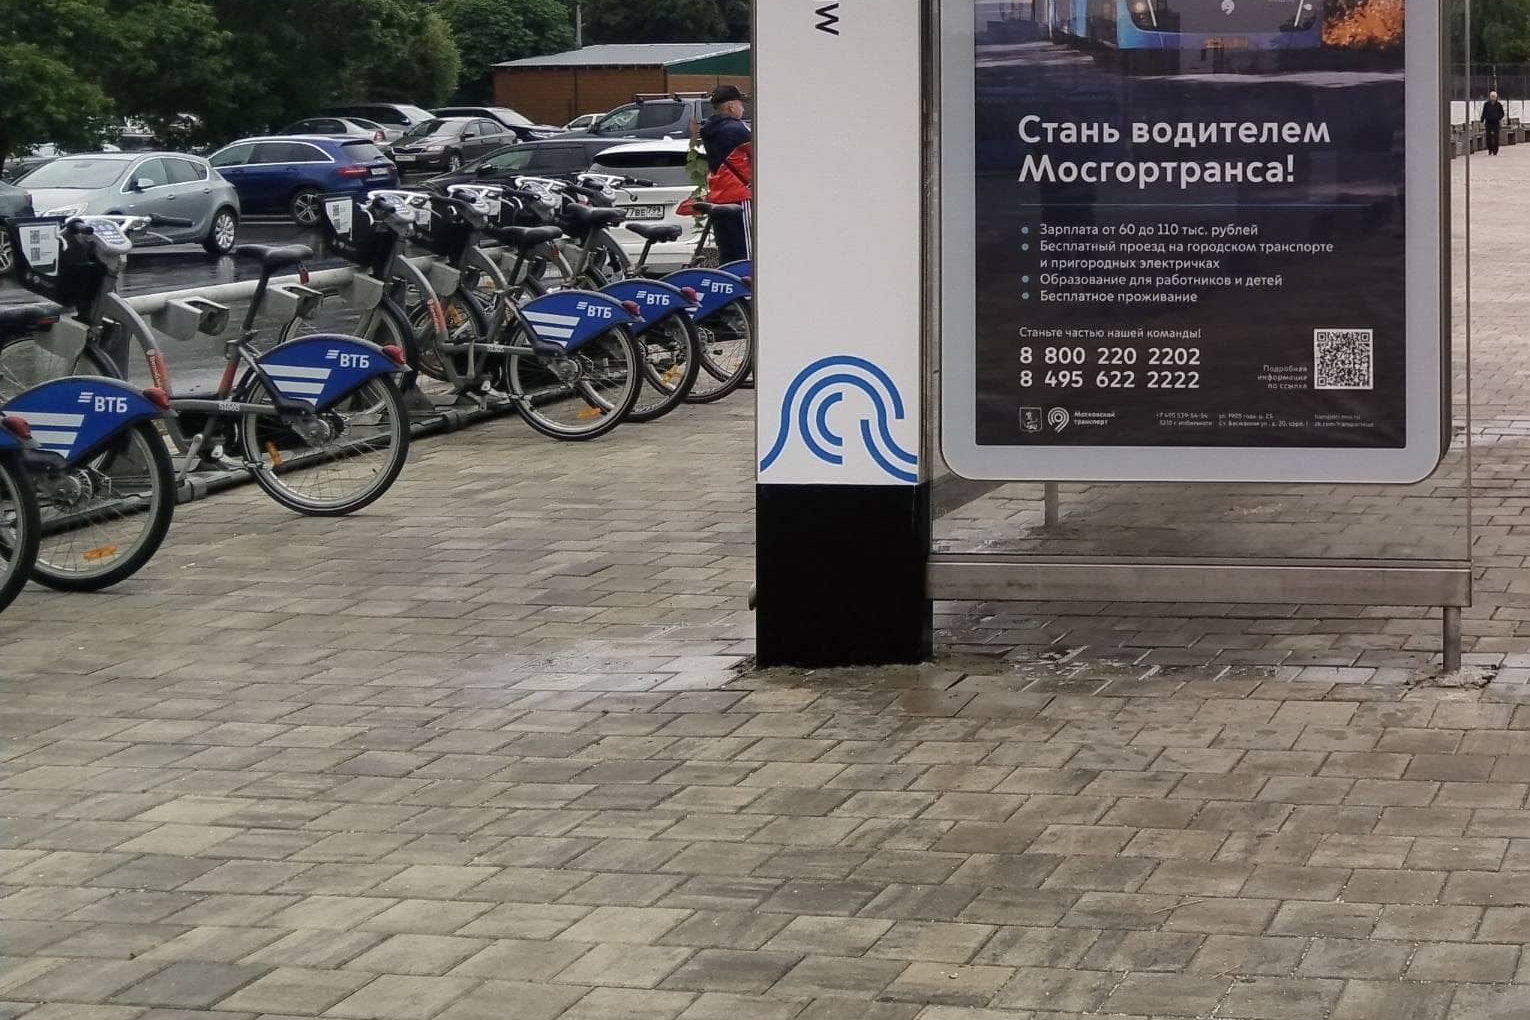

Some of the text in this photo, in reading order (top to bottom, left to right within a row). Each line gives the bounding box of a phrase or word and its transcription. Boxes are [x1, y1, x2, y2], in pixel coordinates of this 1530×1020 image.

[1018, 114, 1331, 147] Стань водителем
[1018, 154, 1295, 189] Мосгортранса!
[624, 207, 645, 216] 77ВЕ
[1040, 223, 1258, 237] Зарплата от 60 до 110 тыс. рублей
[1040, 240, 1334, 254] Бесплатный проезд на городском транспорте
[1040, 258, 1220, 271] и пригородных электричках
[1040, 273, 1283, 287] Образование для работников и детей
[710, 282, 734, 294] ВТБ
[646, 293, 670, 306] ВТБ
[1040, 290, 1198, 304] Бесплатное проживание
[587, 304, 612, 319] ВТБ
[1019, 327, 1202, 340] Станьте частью нашей команды!
[340, 353, 370, 369] ВТБ
[1019, 346, 1201, 365] 8 800 220 2202
[1019, 370, 1200, 389] 8 495 622 2222
[94, 396, 128, 413] ВТБ
